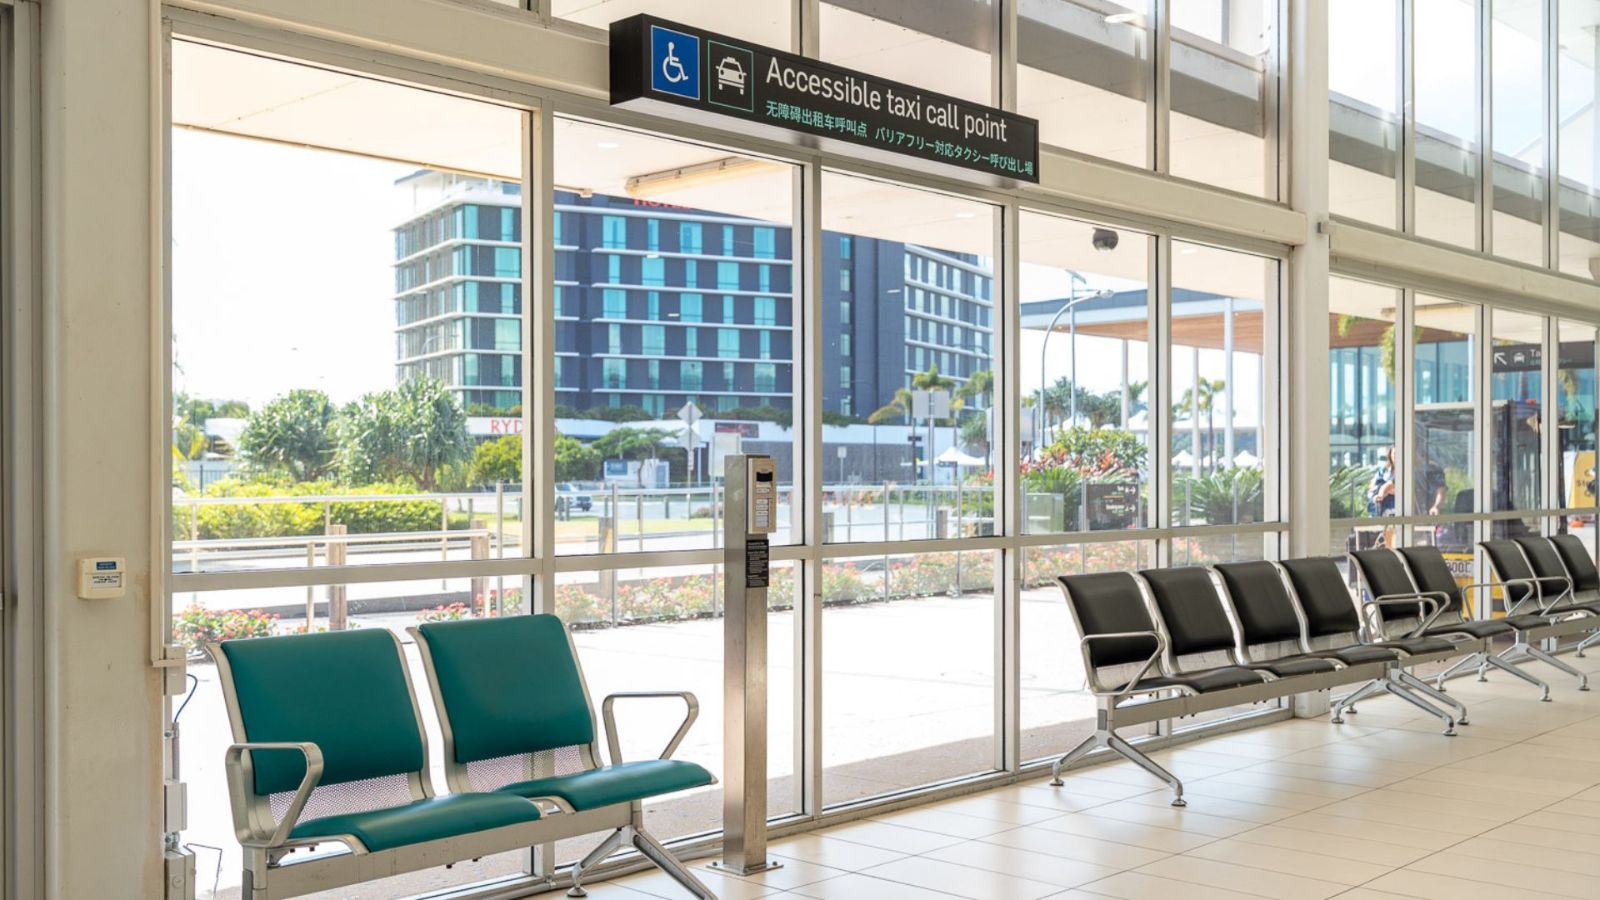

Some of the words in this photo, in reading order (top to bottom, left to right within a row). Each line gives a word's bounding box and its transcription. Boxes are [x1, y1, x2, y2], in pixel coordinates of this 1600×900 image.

[766, 57, 881, 110] Accessible
[886, 89, 921, 120] taxi
[926, 104, 959, 130] call
[964, 113, 1007, 142] point
[766, 100, 867, 138] 无障碍出租车呼叫点
